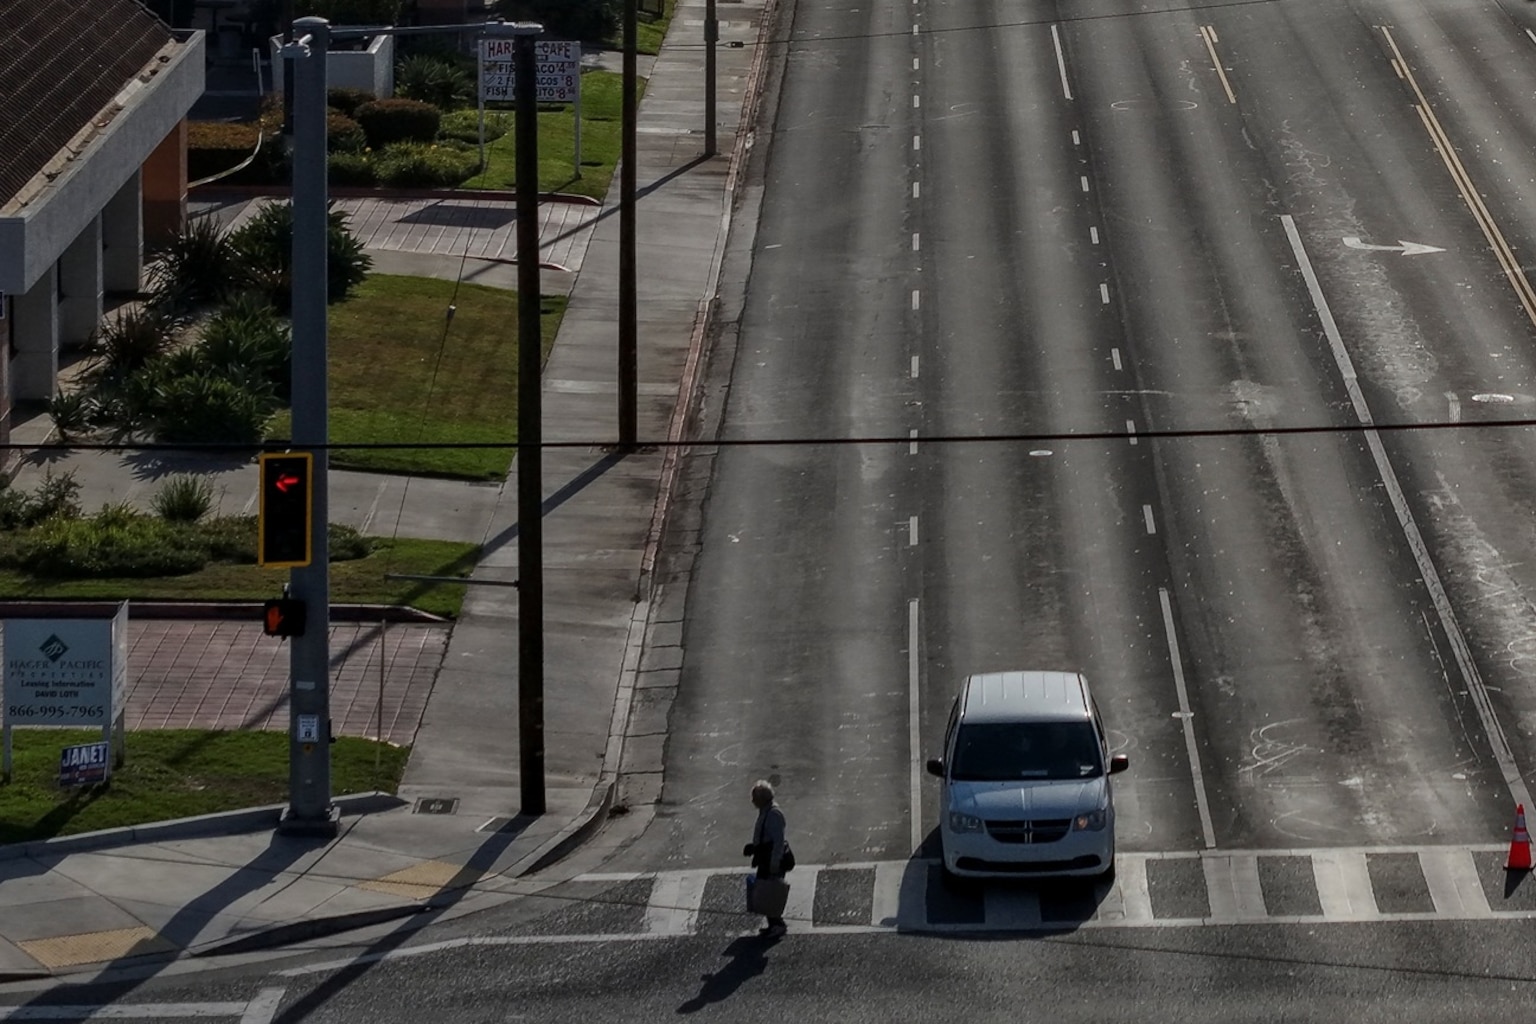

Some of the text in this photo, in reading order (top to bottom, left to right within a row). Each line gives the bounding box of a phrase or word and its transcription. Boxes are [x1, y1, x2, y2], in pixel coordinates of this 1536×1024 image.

[499, 63, 515, 73] FIS
[497, 76, 503, 85] 2
[486, 87, 508, 96] FISH
[9, 659, 104, 670] HAGER PACIFIC
[52, 679, 95, 688] Information
[35, 690, 57, 698] DAVID
[9, 704, 104, 718] 866-995-7965
[62, 744, 106, 767] JANET
